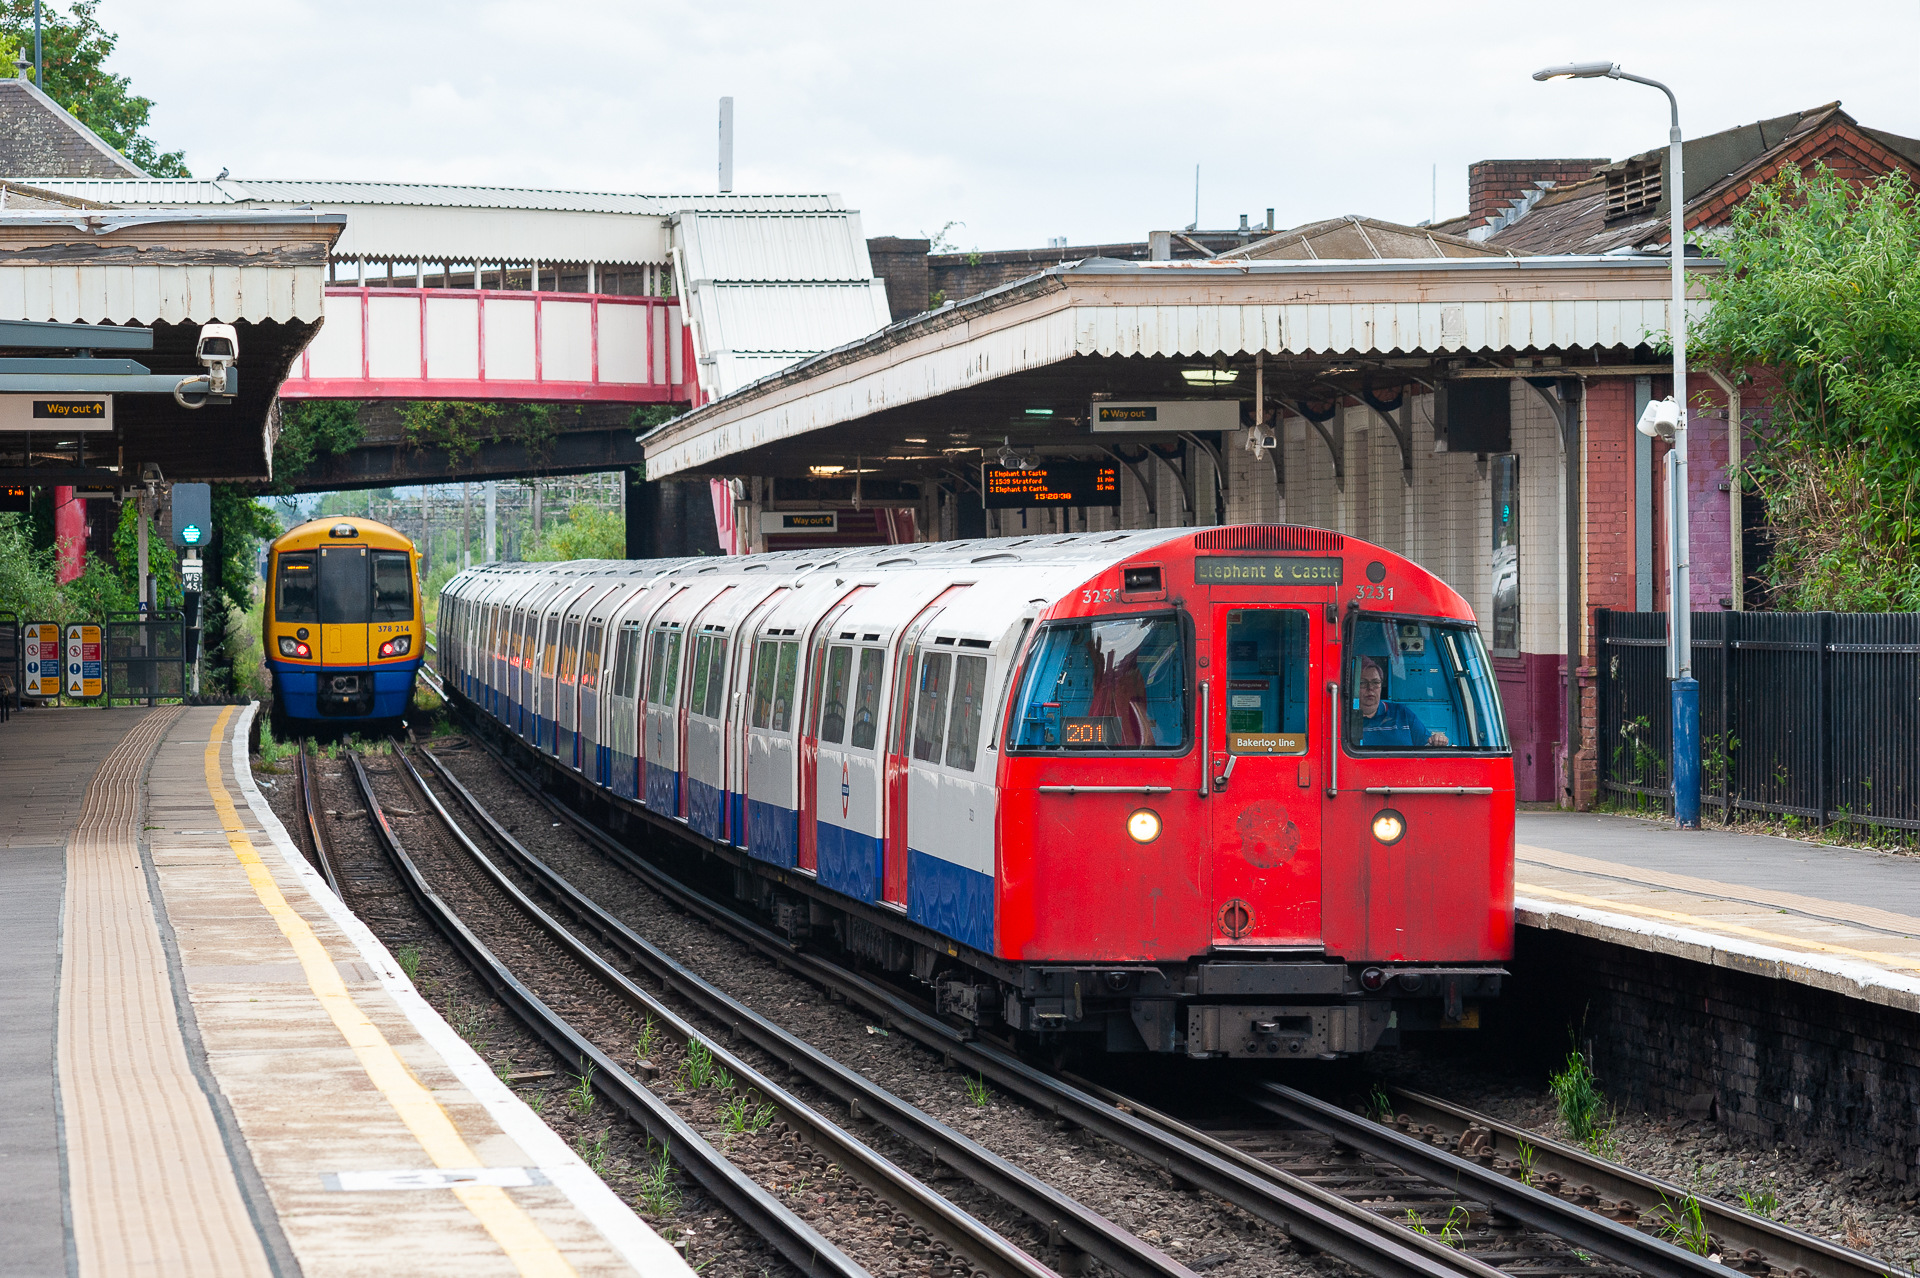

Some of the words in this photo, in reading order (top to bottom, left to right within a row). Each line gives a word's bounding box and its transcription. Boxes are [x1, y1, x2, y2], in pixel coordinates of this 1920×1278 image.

[47, 403, 70, 415] Way
[72, 404, 91, 414] out
[1110, 409, 1129, 420] Way
[1130, 410, 1146, 418] out
[994, 470, 1020, 478] Elephant
[1028, 469, 1048, 477] Castle
[1012, 477, 1043, 485] Stratford
[14, 488, 25, 496] min
[995, 485, 1021, 494] Elephant
[792, 517, 809, 526] Way
[1273, 564, 1284, 579] &
[1292, 564, 1341, 579] Castle
[185, 572, 200, 582] WS
[1082, 588, 1120, 604] 3231
[1355, 584, 1394, 601] 3231
[140, 603, 148, 611] A
[377, 625, 392, 633] 378
[395, 625, 410, 633] 214
[1066, 724, 1102, 742] 201
[1237, 738, 1276, 747] Bakerloo
[1278, 738, 1296, 747] line
